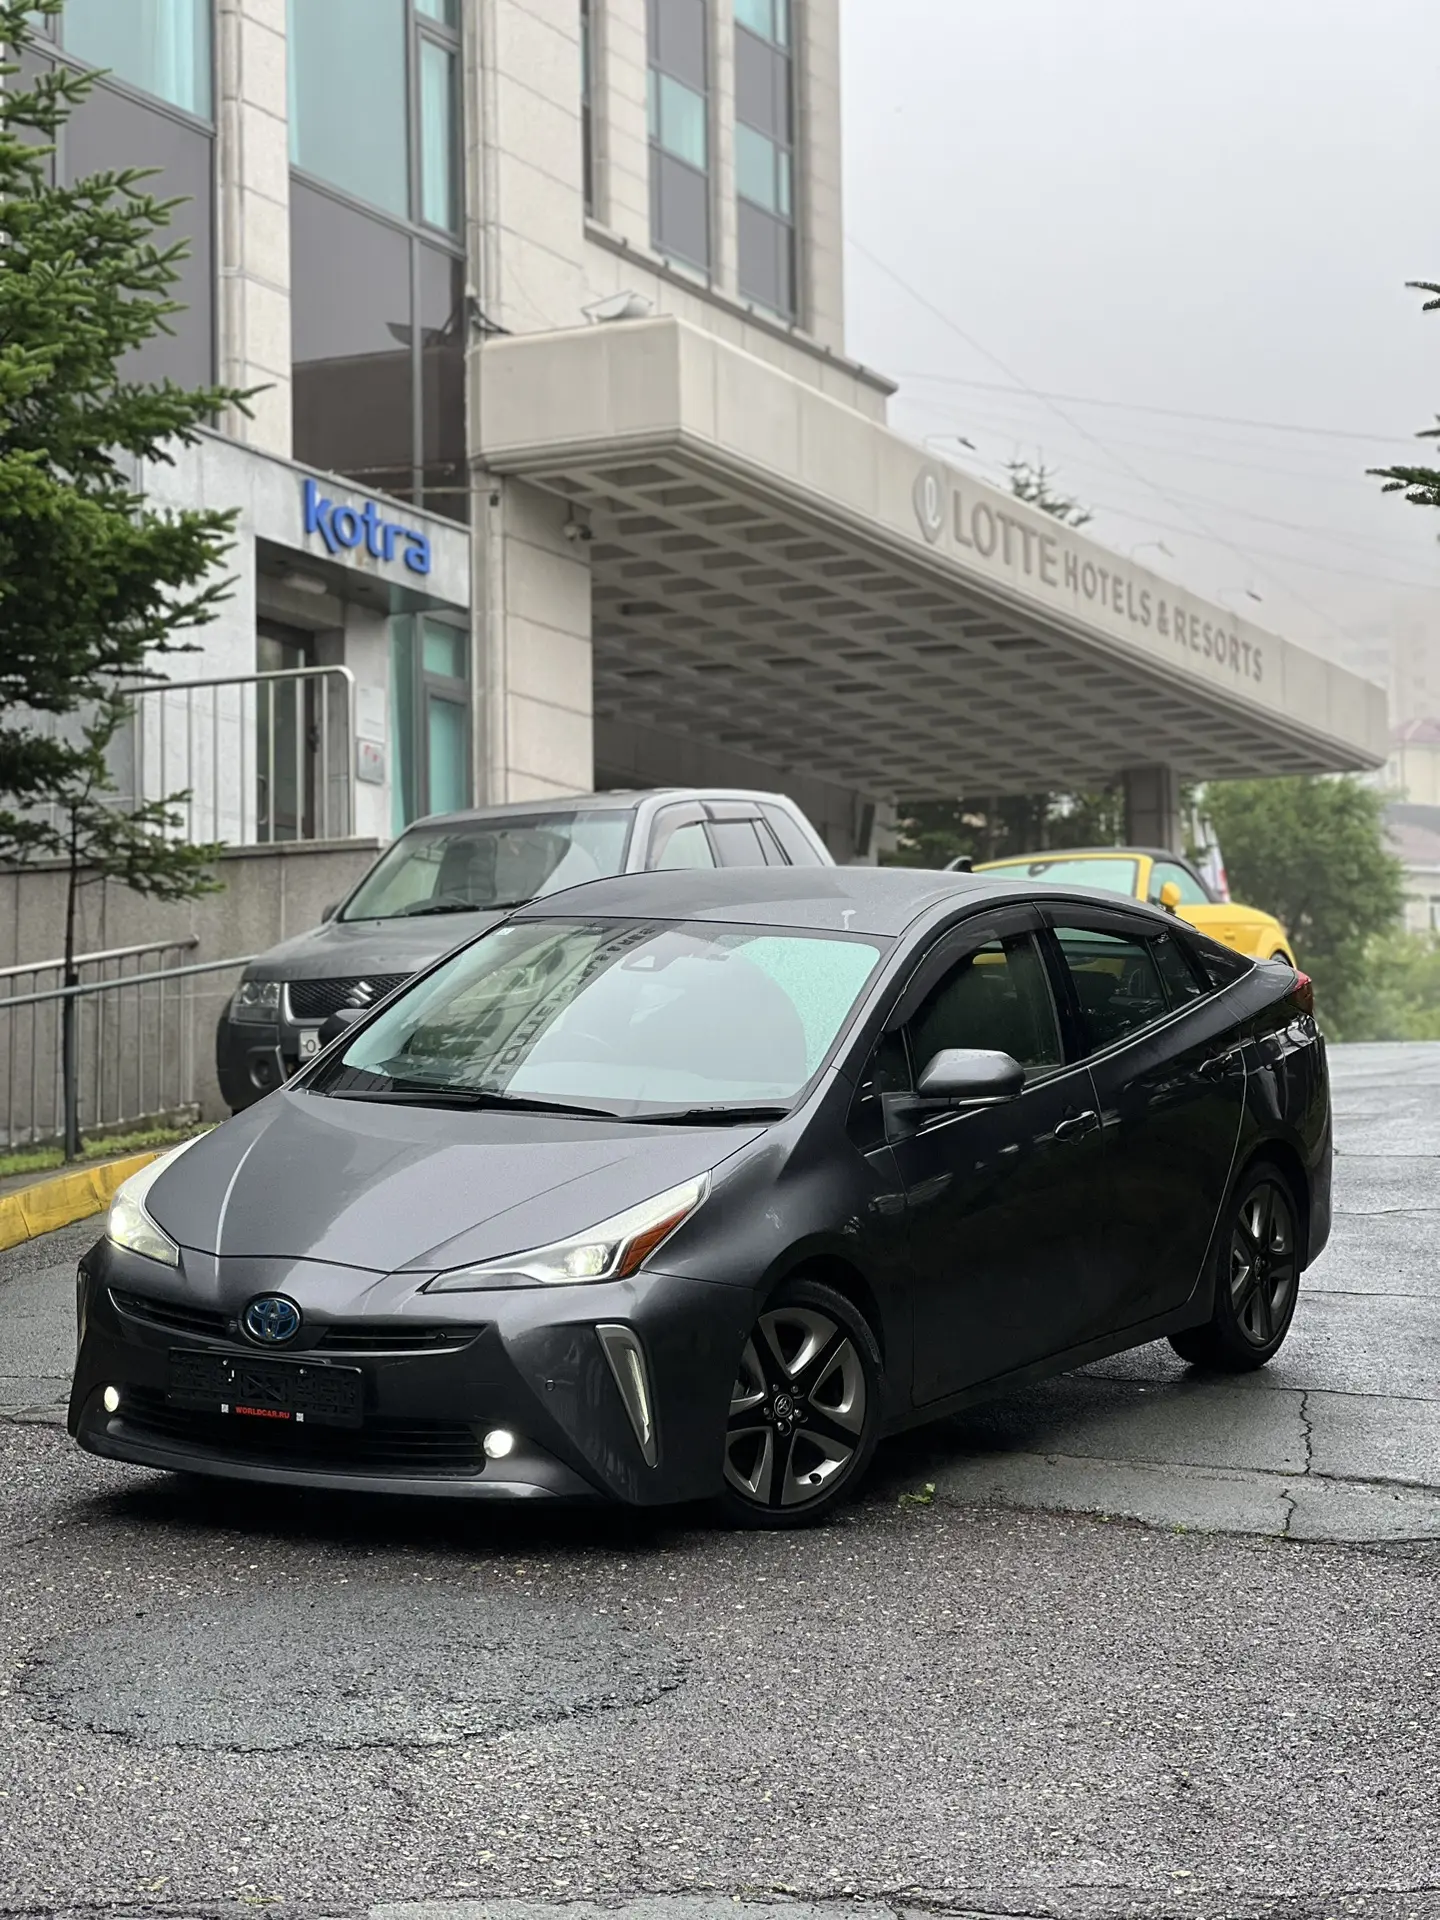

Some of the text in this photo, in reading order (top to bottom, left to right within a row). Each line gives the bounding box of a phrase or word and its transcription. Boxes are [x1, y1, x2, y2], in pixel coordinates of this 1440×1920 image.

[304, 478, 431, 574] kotra
[953, 489, 1262, 682] LOTTE HOTELS & RESORTS
[235, 1406, 290, 1419] WORLDCAR.RU
